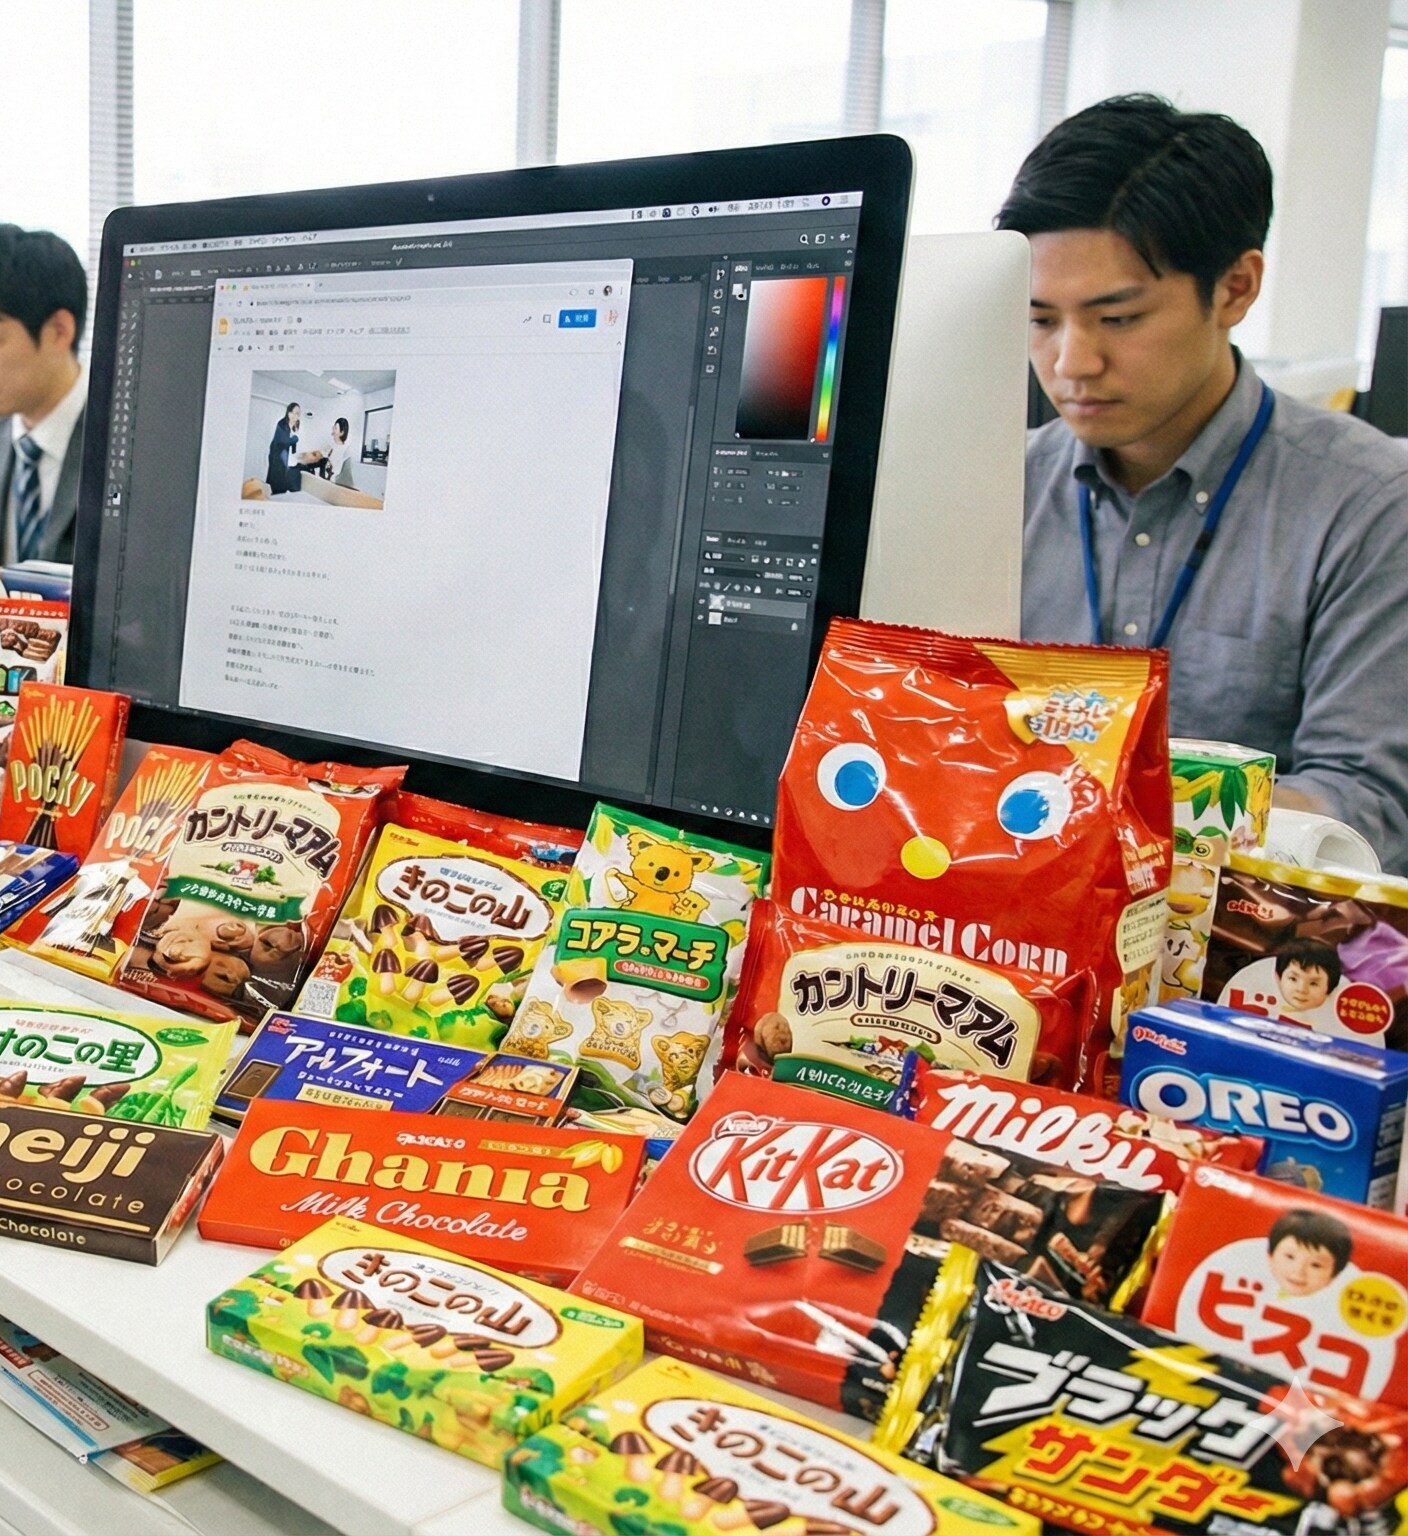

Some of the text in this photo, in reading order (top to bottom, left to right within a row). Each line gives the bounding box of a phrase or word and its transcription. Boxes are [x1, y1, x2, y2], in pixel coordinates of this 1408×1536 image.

[10, 760, 95, 816] POCKY
[186, 804, 342, 880] カントリーマアム
[393, 865, 532, 930] きのこの山
[792, 966, 1019, 1067] カントリーマアム
[285, 1035, 443, 1087] アルフォート
[1138, 1071, 1351, 1141] OREO
[706, 1125, 890, 1210] KitKat
[280, 1191, 529, 1243] Milk Chocolate
[342, 1252, 532, 1337] きのこの山
[1198, 1270, 1371, 1398] ビスコ
[977, 1341, 1286, 1466] ブラック
[670, 1406, 901, 1525] きのこの山
[1024, 1423, 1277, 1513] サンダー
